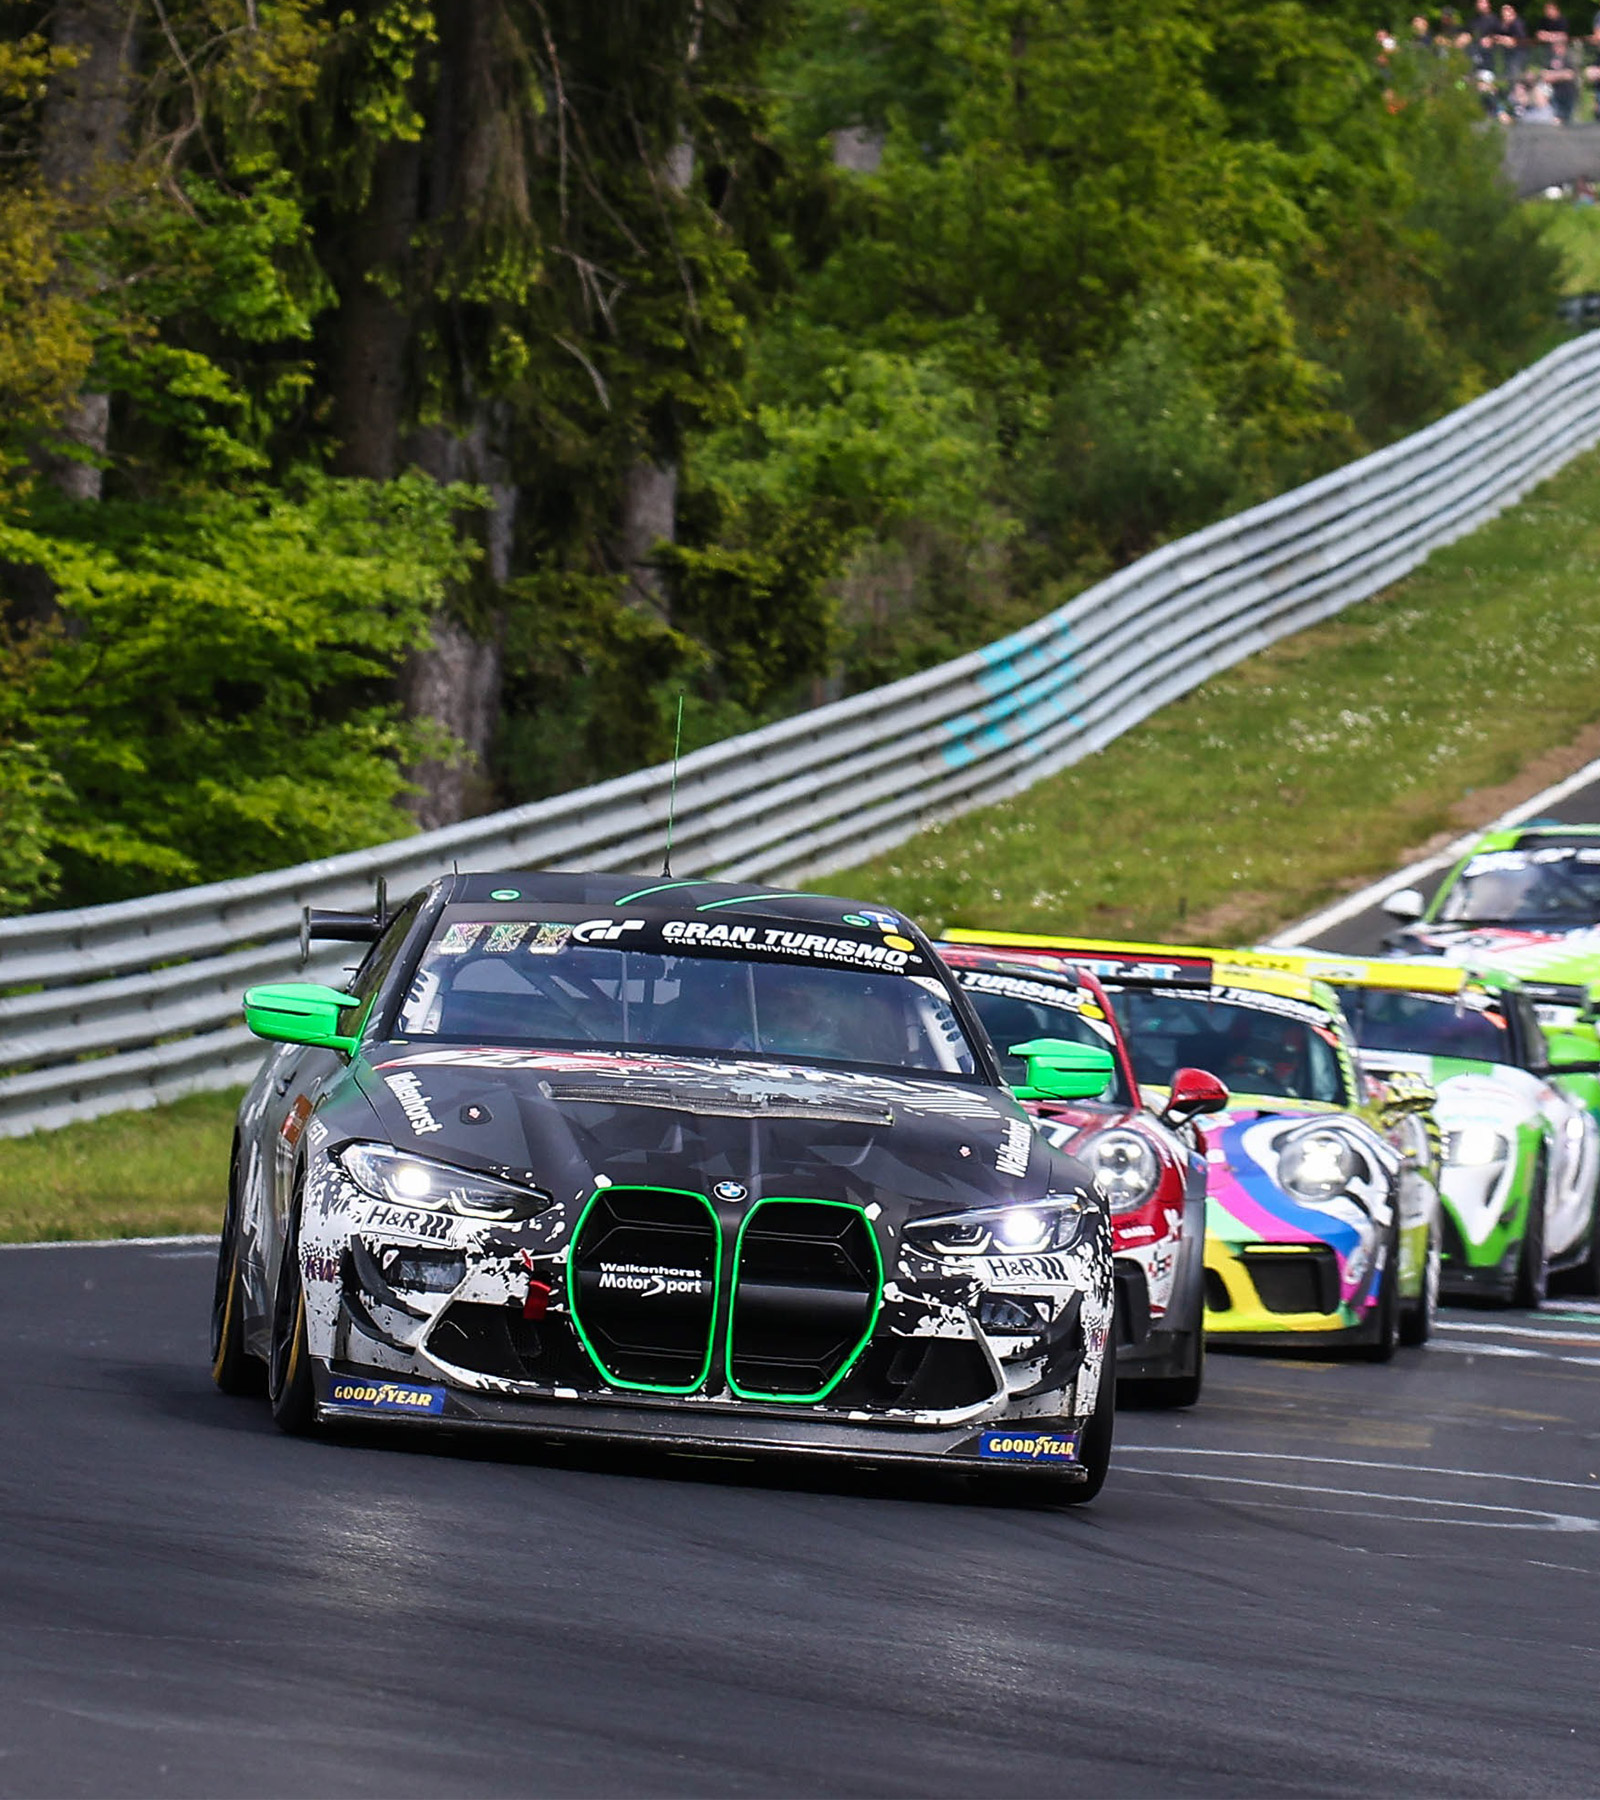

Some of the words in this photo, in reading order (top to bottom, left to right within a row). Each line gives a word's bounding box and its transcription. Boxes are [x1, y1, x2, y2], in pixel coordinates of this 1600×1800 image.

[661, 920, 757, 942] GRAN
[664, 937, 697, 946] THE
[700, 939, 743, 949] REAL
[746, 943, 811, 956] DRIVING
[814, 950, 905, 974] SIMULATOR
[963, 971, 1085, 1006] TURISMO
[384, 1071, 443, 1135] Walkenhorst
[599, 1262, 702, 1277] Walkenhorst
[334, 1383, 433, 1407] GOODYEAR
[990, 1436, 1075, 1458] GOODYEAR
